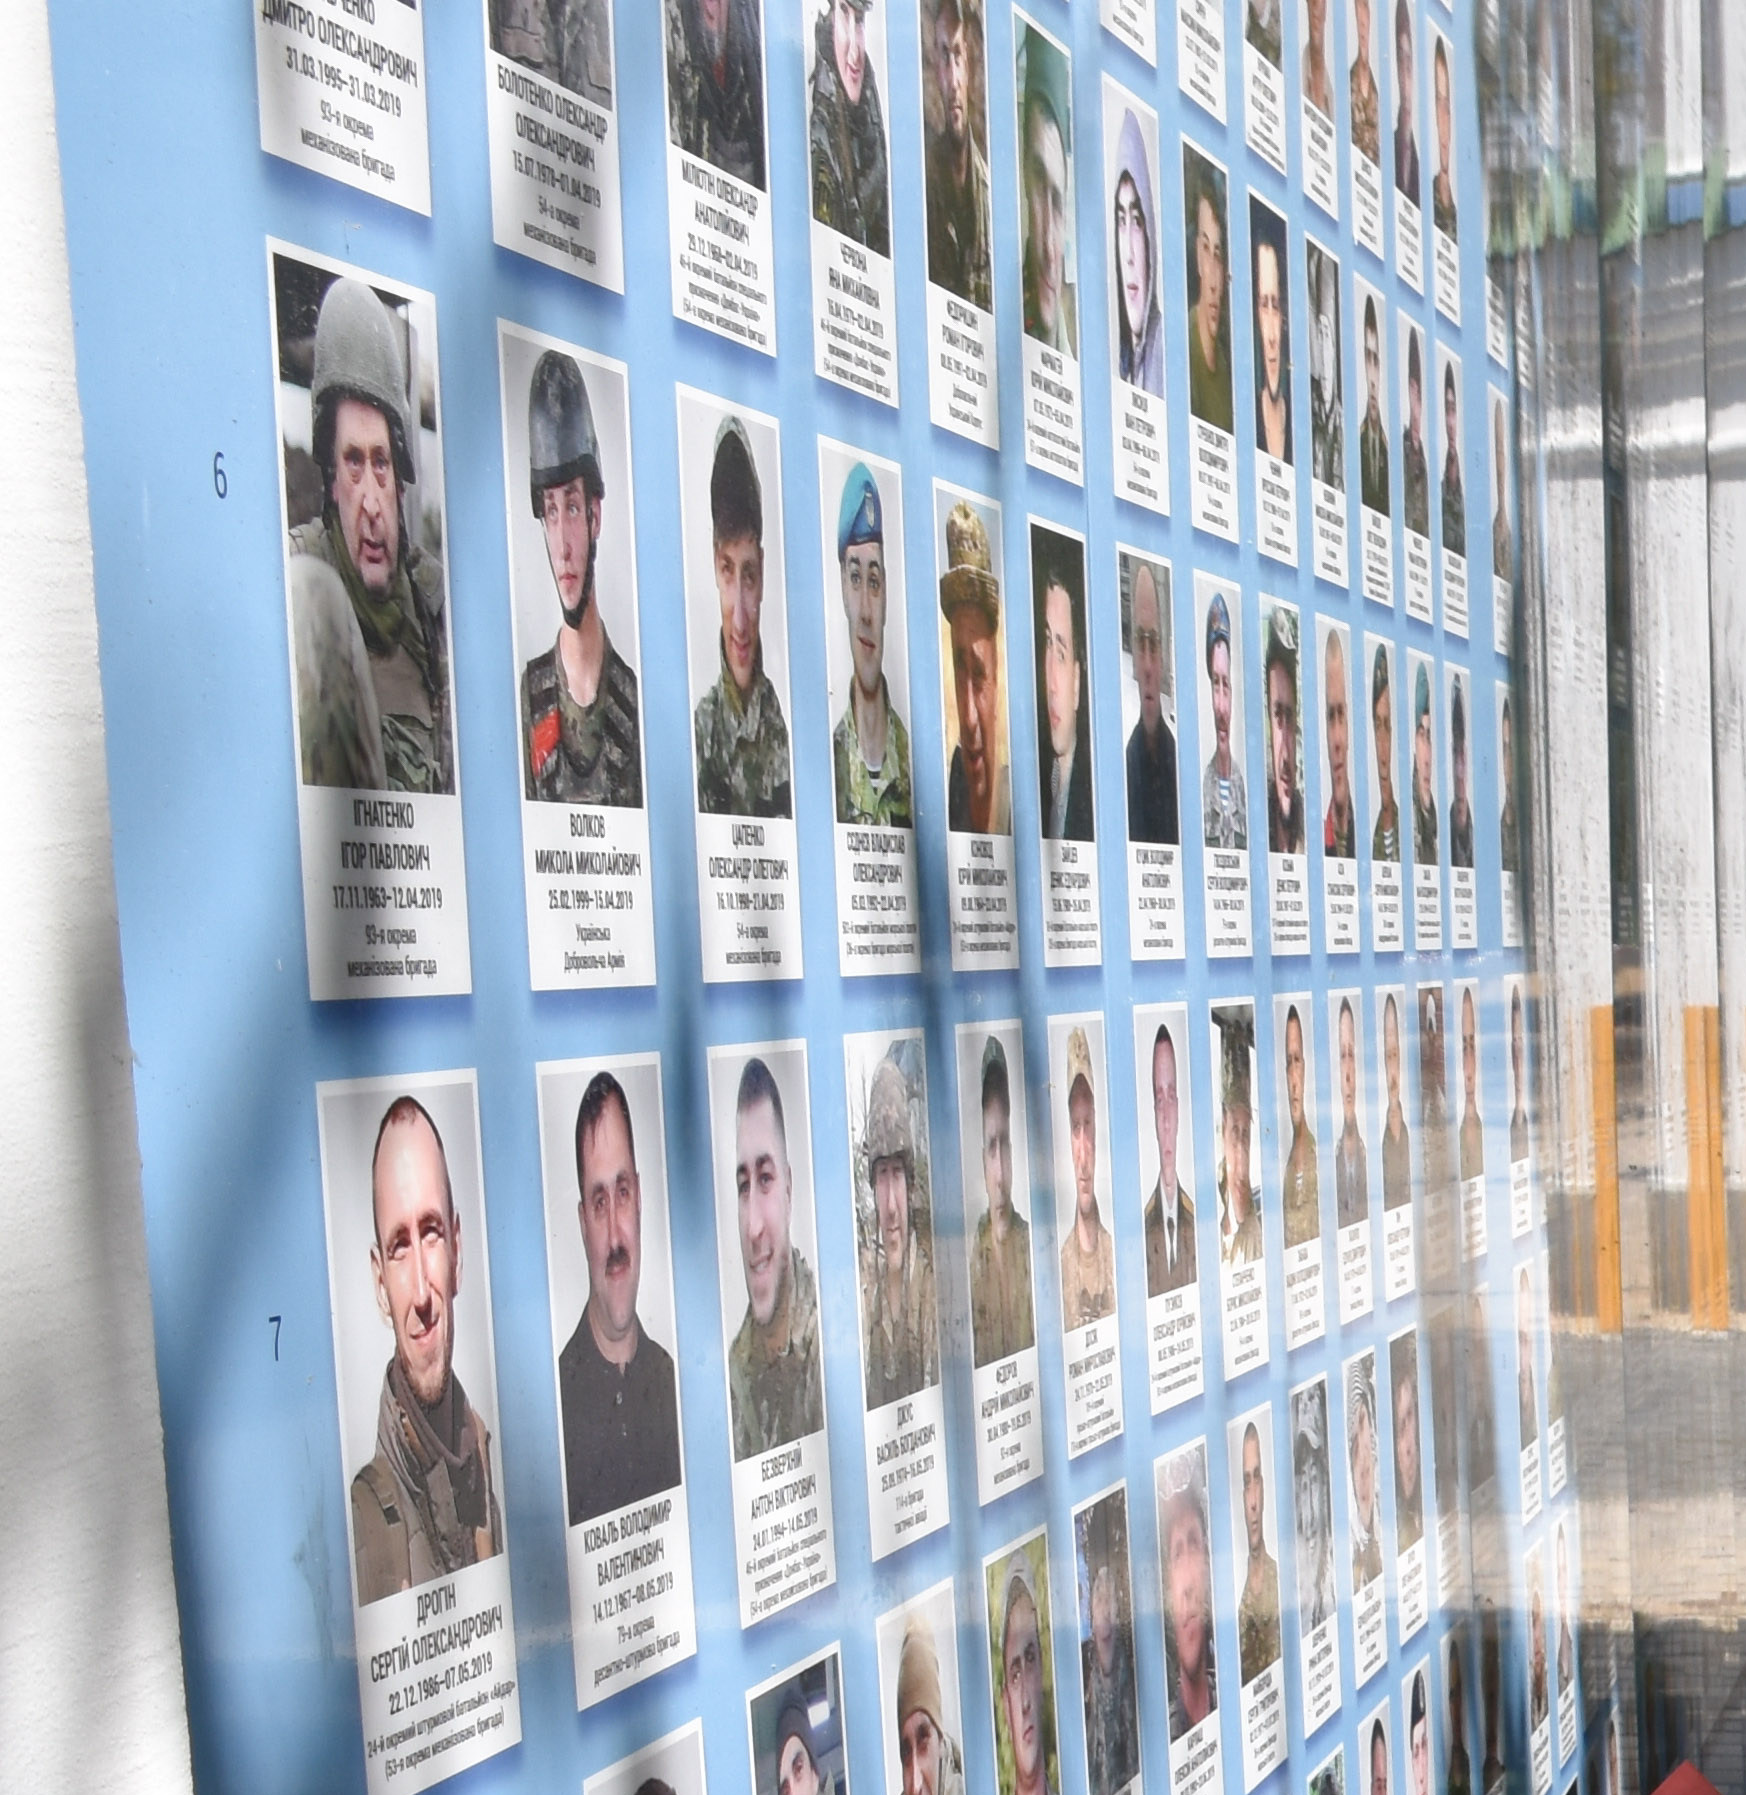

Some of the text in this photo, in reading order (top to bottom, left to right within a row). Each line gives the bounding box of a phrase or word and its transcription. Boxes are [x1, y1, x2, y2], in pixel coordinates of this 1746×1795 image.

[261, 0, 419, 88] ДМИТРО ОЛЕКСАНДРОВИЧ
[555, 94, 608, 144] ОЛЕКСАНДР
[214, 451, 227, 499] 6
[353, 798, 415, 829] ІГНАТЕНКО
[569, 812, 606, 838] ВОЛКОВ
[341, 841, 431, 870] ІГОР ПАВЛОВИЧ
[534, 845, 642, 876] МИКОЛА МИКОЛАЙОВИЧ
[708, 857, 752, 884] ОЛЕКСАНДР
[387, 928, 417, 950] окрема
[405, 954, 438, 980] бригада
[268, 1315, 281, 1362] 7
[583, 1498, 673, 1555] КОВАЛЬ ВОЛОДИМИР
[751, 1491, 775, 1521] АНТОН
[596, 1537, 666, 1587] ВАЛЕНТИНОВИЧ
[416, 1582, 457, 1628] ДРОГІН
[370, 1603, 503, 1684] СЕРГІЙ ОЛЕКСАНДРОВИЧ
[367, 1734, 385, 1759] 24-й
[385, 1721, 416, 1750] окремий
[455, 1691, 490, 1716] батальйон
[405, 1746, 431, 1770] окрема
[431, 1727, 477, 1757] механізована
[477, 1704, 505, 1736] бригада)
